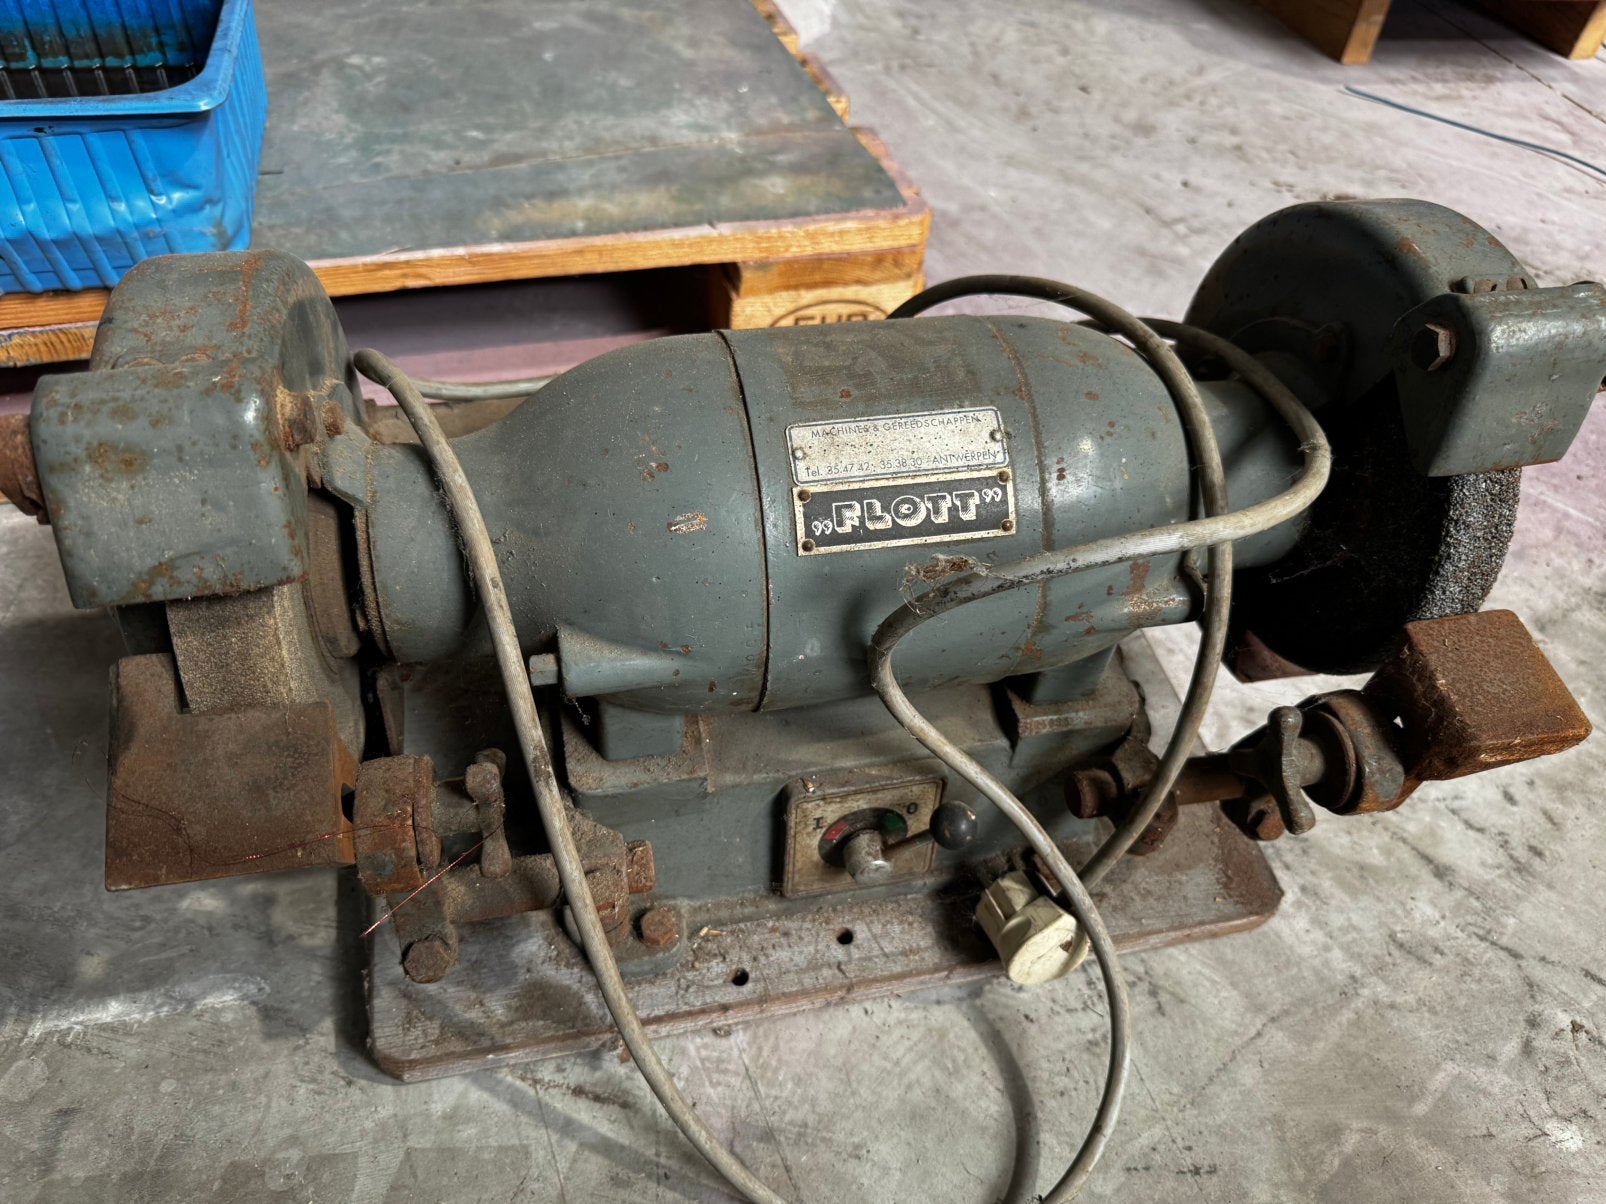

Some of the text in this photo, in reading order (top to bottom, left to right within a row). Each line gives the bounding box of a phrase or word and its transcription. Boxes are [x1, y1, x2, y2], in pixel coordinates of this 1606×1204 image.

[811, 415, 982, 439] MACHINES & GEREEDSCHAPPEN
[804, 466, 823, 477] Tel.
[932, 450, 998, 465] ANTWERPEN
